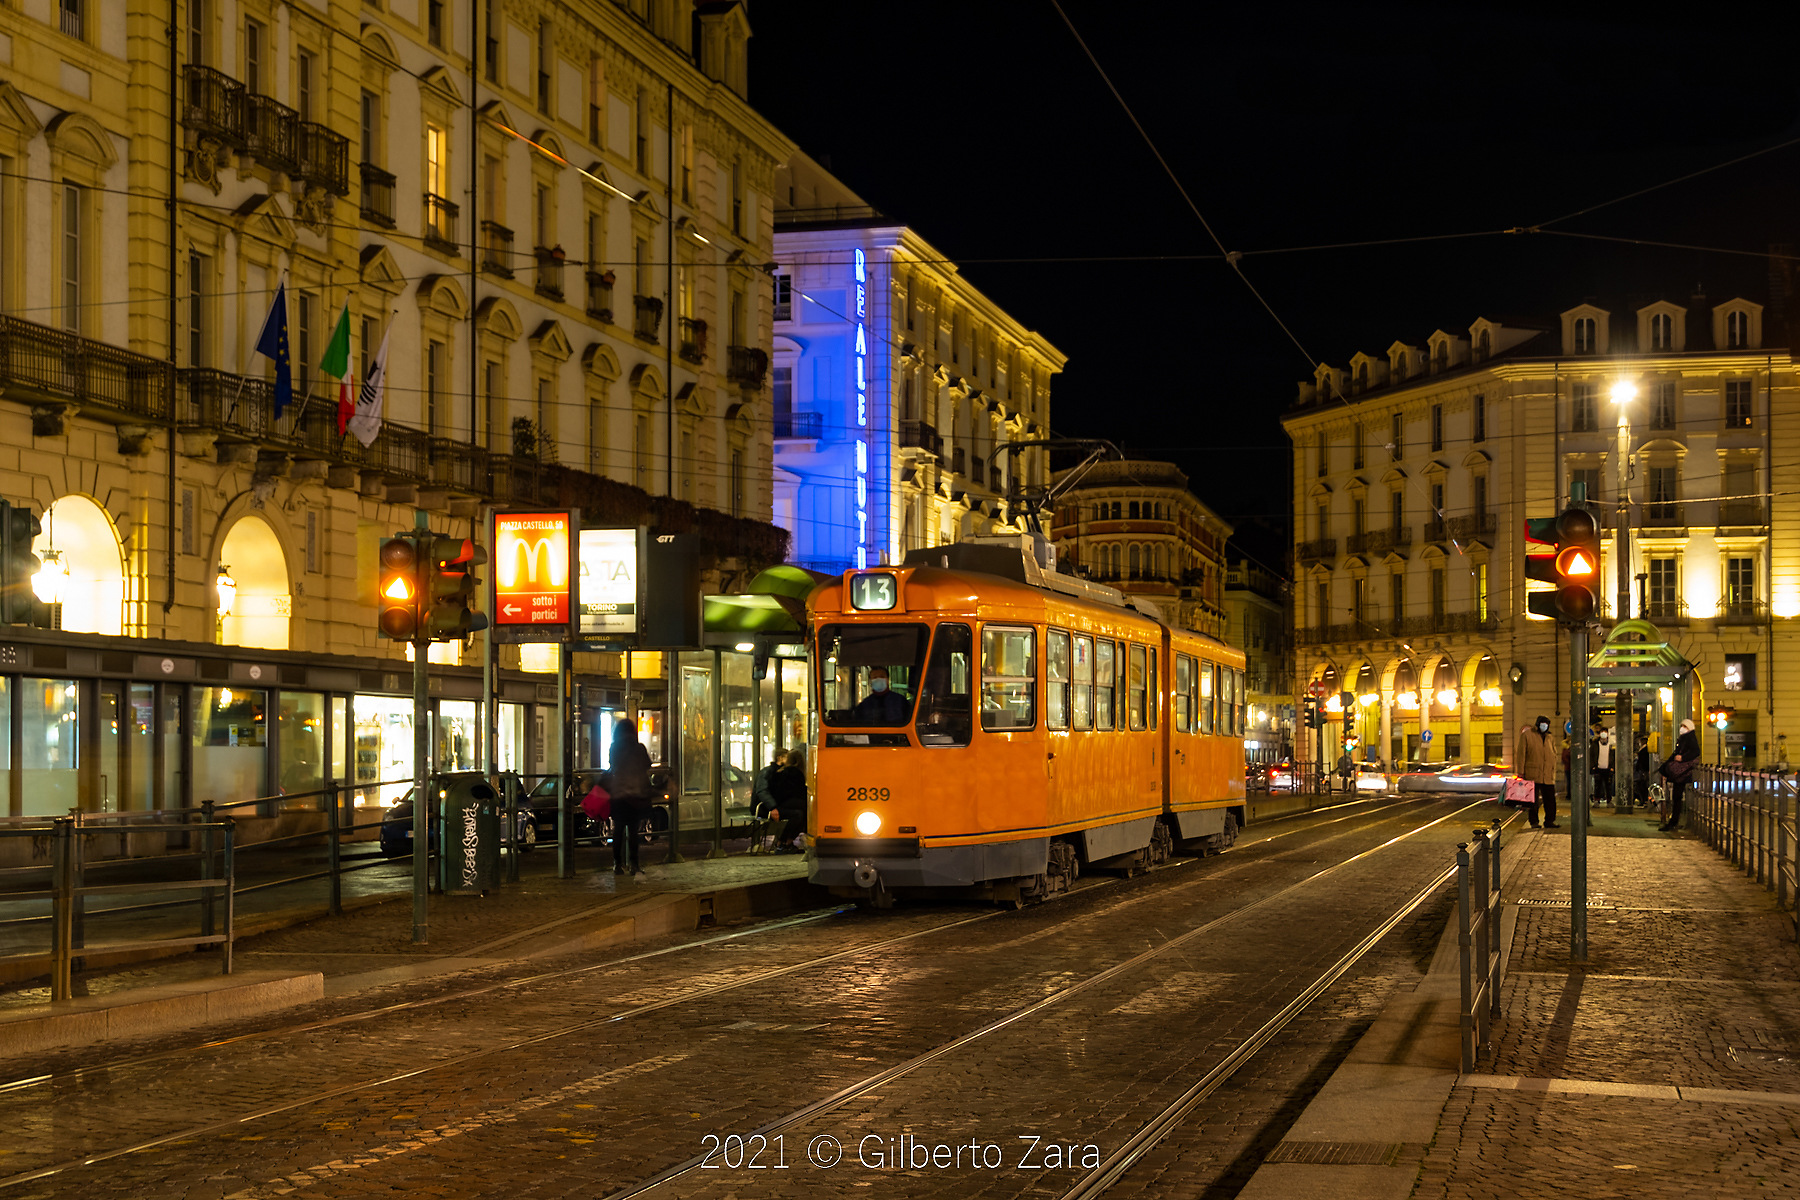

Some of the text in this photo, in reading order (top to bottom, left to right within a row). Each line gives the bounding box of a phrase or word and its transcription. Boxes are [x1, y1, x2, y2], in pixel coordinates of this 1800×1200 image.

[855, 248, 867, 427] REALE
[500, 521, 522, 531] PIAZZA
[522, 521, 555, 531] CASTELLO,
[656, 535, 675, 543] GTT
[580, 559, 631, 581] ATA
[532, 594, 557, 606] sotto i
[861, 578, 890, 608] 13
[586, 603, 618, 611] TORINO
[531, 608, 558, 622] portici
[847, 787, 891, 801] 2839
